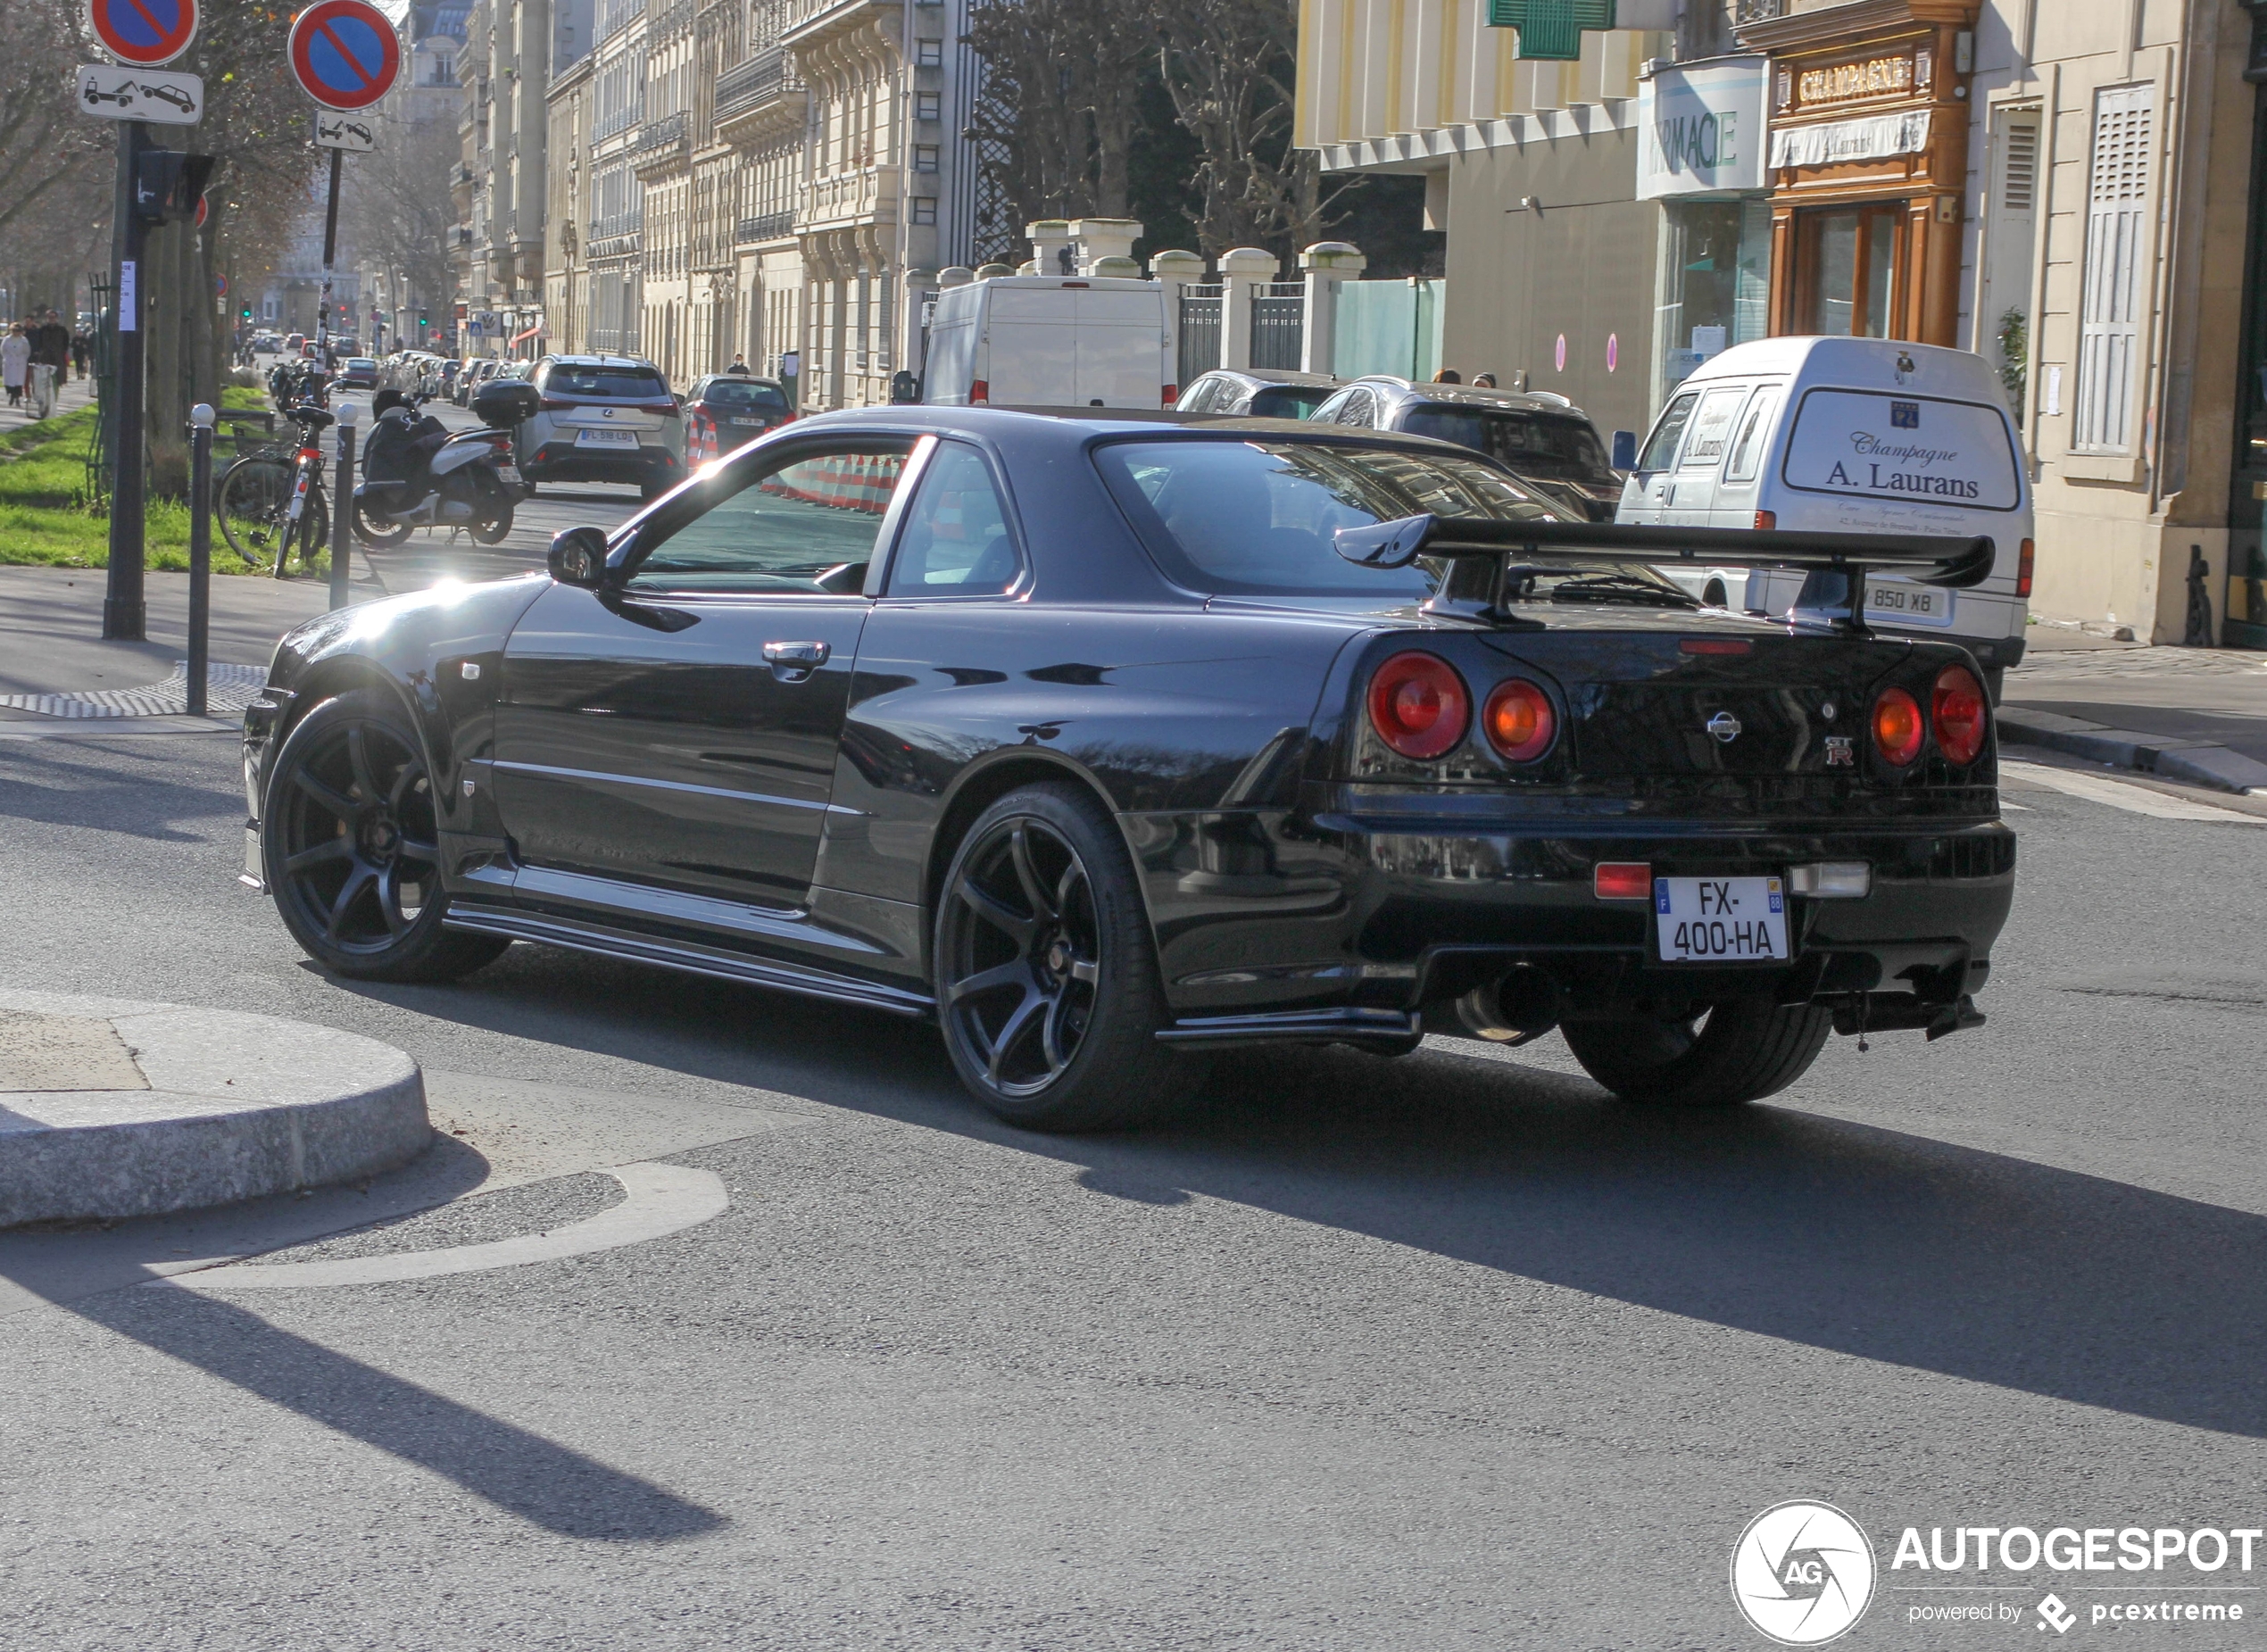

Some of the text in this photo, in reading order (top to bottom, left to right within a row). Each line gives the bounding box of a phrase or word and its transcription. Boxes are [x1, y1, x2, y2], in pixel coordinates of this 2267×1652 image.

[1798, 57, 1904, 102] CHAMPAGNE
[1849, 431, 1958, 468] Champagne
[1826, 460, 1980, 499] A. Laurans
[1880, 520, 1889, 528] de
[1875, 589, 1905, 609] 850
[1911, 593, 1931, 612] XB
[1661, 895, 1781, 910] F 88
[1698, 882, 1740, 915] FX-
[1674, 920, 1773, 955] 400-HA
